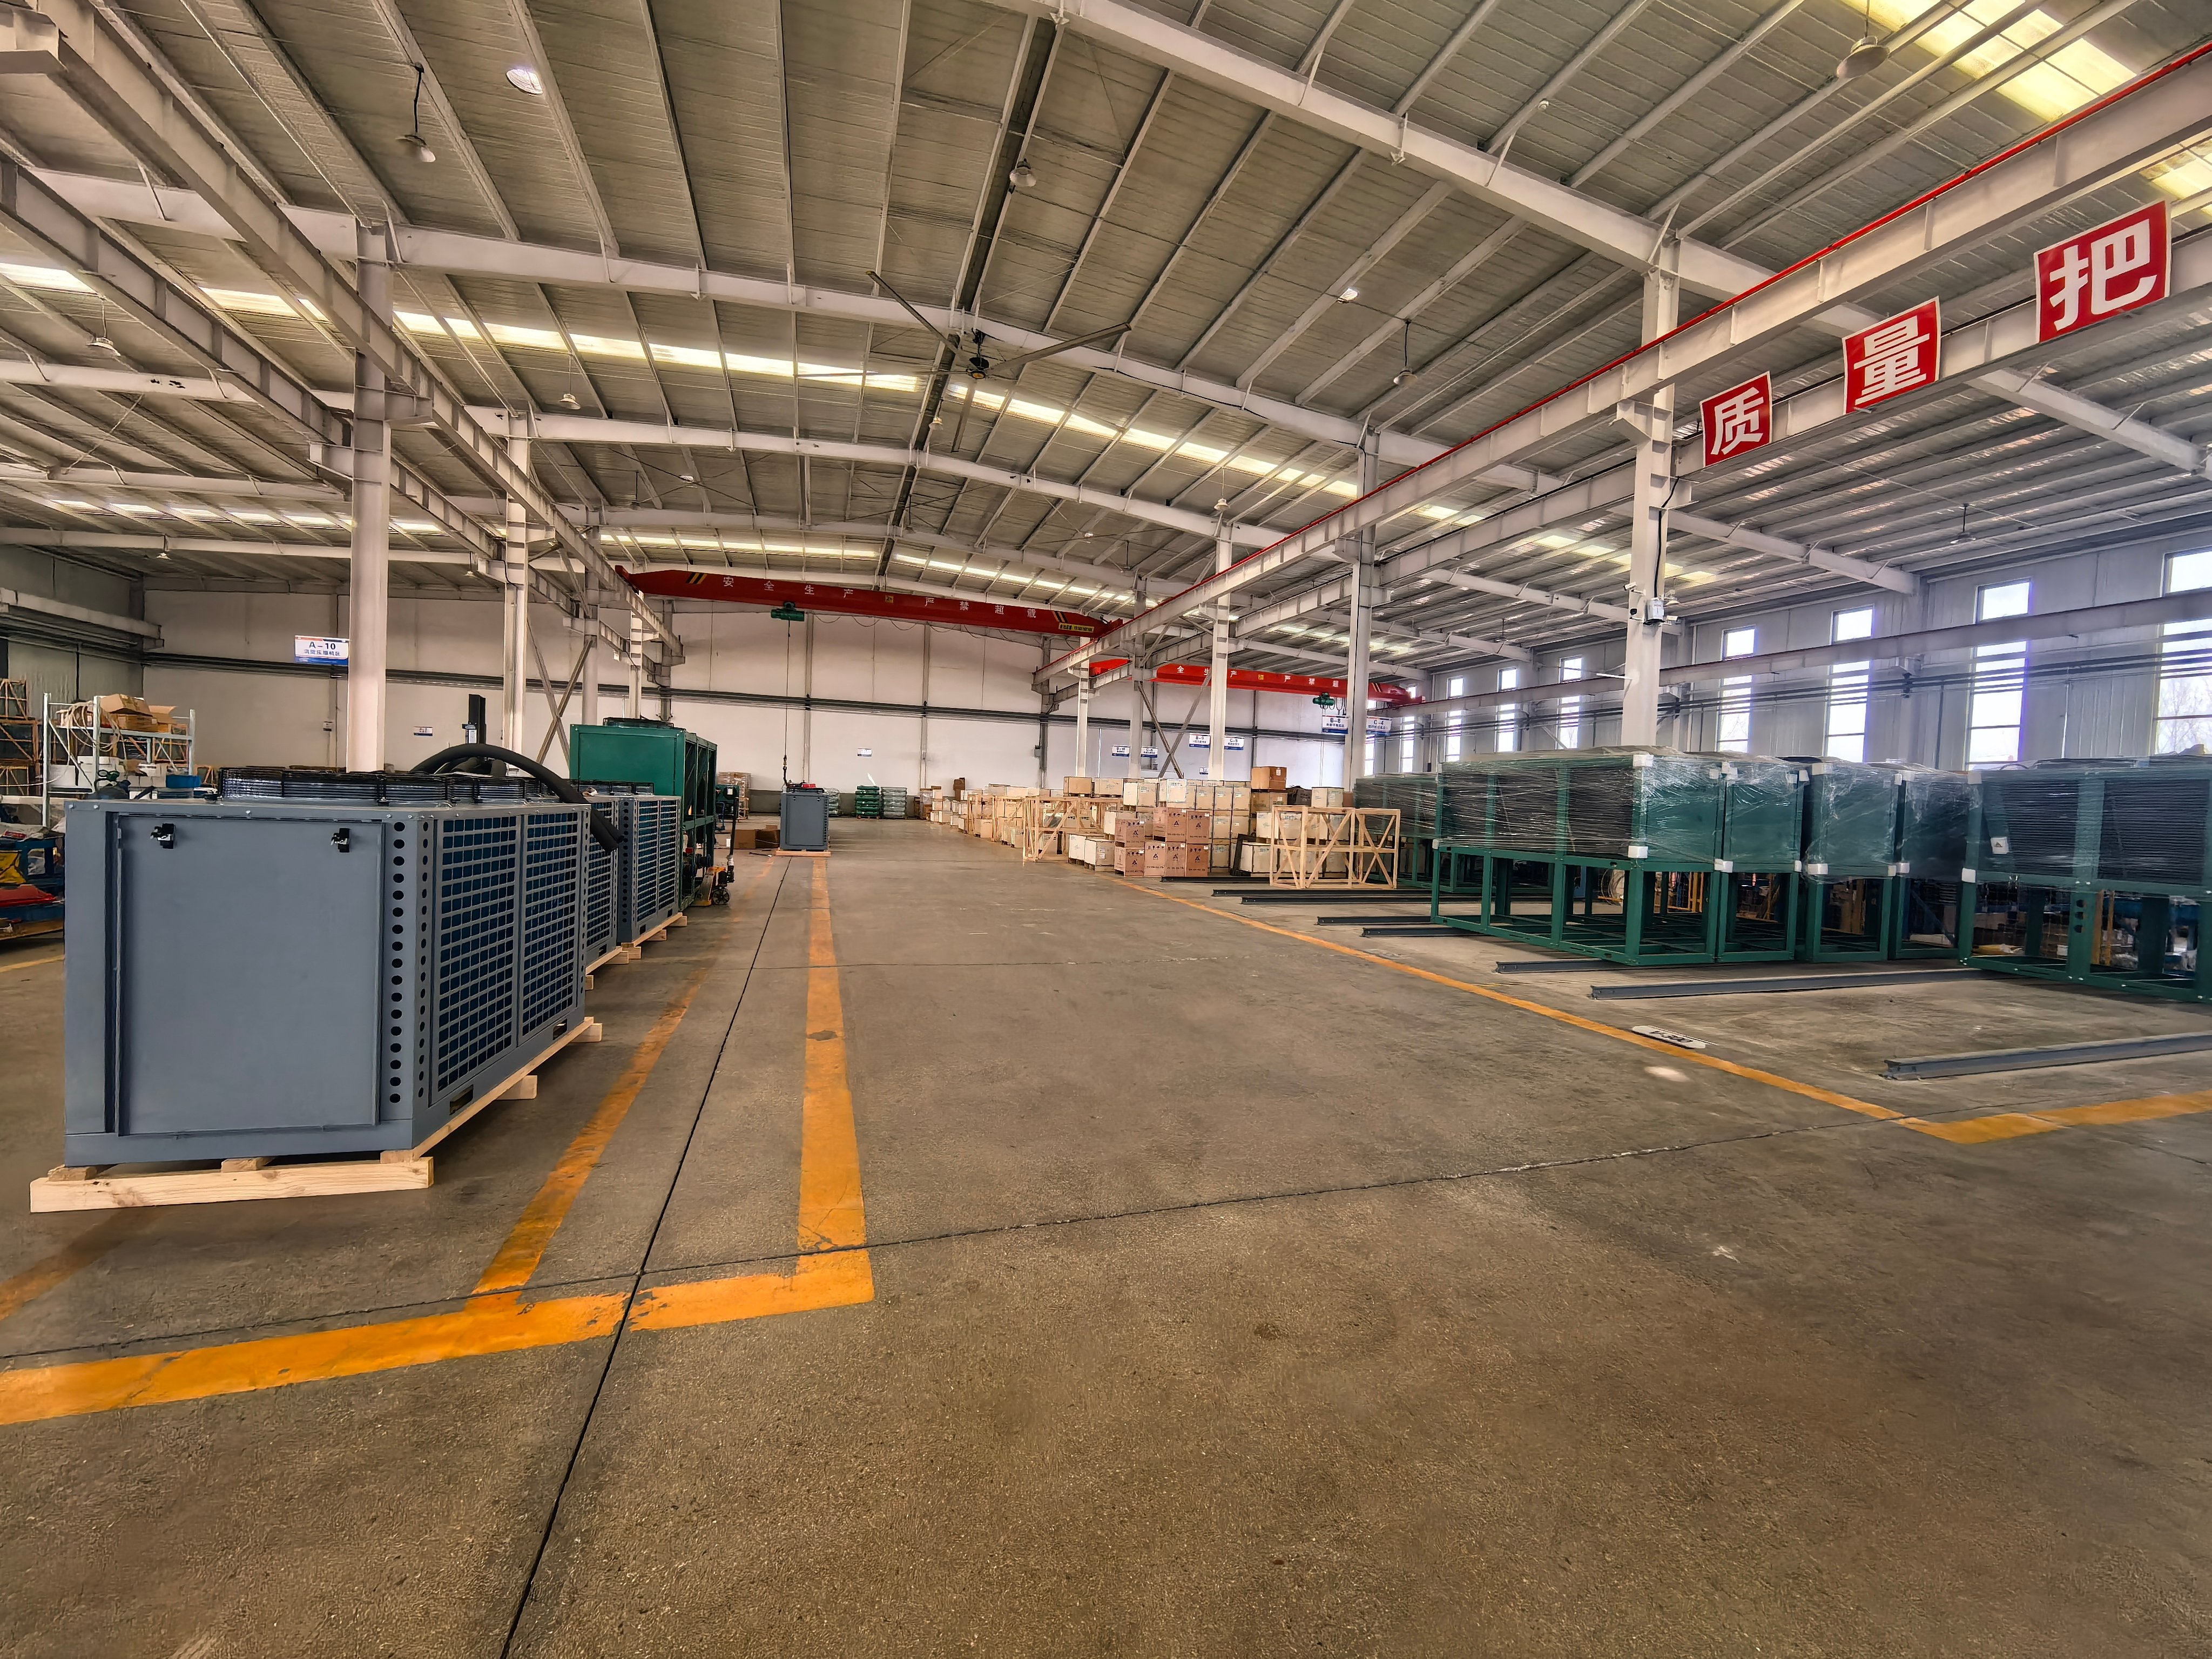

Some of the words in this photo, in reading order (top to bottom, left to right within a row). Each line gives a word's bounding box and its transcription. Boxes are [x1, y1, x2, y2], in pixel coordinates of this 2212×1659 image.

[2049, 218, 2158, 331] 把
[1853, 315, 1930, 406] 量
[1710, 386, 1764, 456] 质
[723, 576, 854, 598] 安全生产
[925, 597, 1036, 618] 严禁超载
[309, 641, 336, 650] A-10
